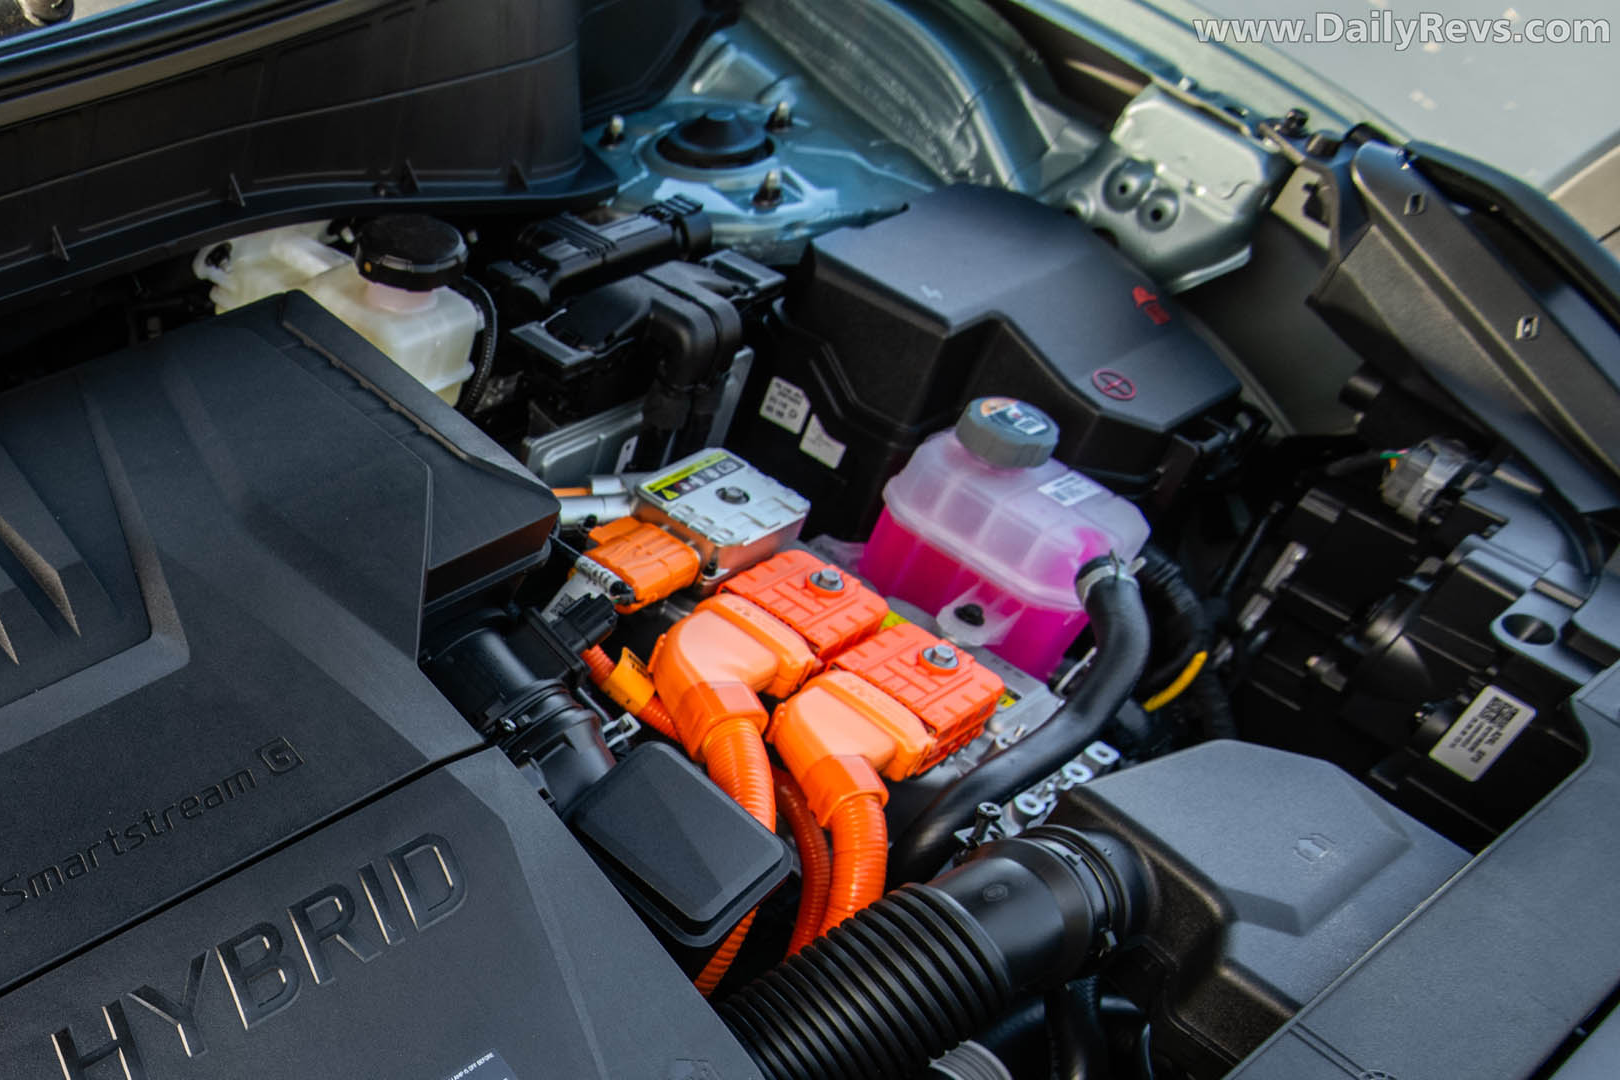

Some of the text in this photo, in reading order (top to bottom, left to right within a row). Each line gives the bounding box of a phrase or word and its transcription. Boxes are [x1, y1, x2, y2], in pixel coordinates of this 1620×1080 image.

[260, 736, 305, 775] G
[467, 1062, 478, 1071] OFF
[476, 1051, 494, 1066] BEFORE
